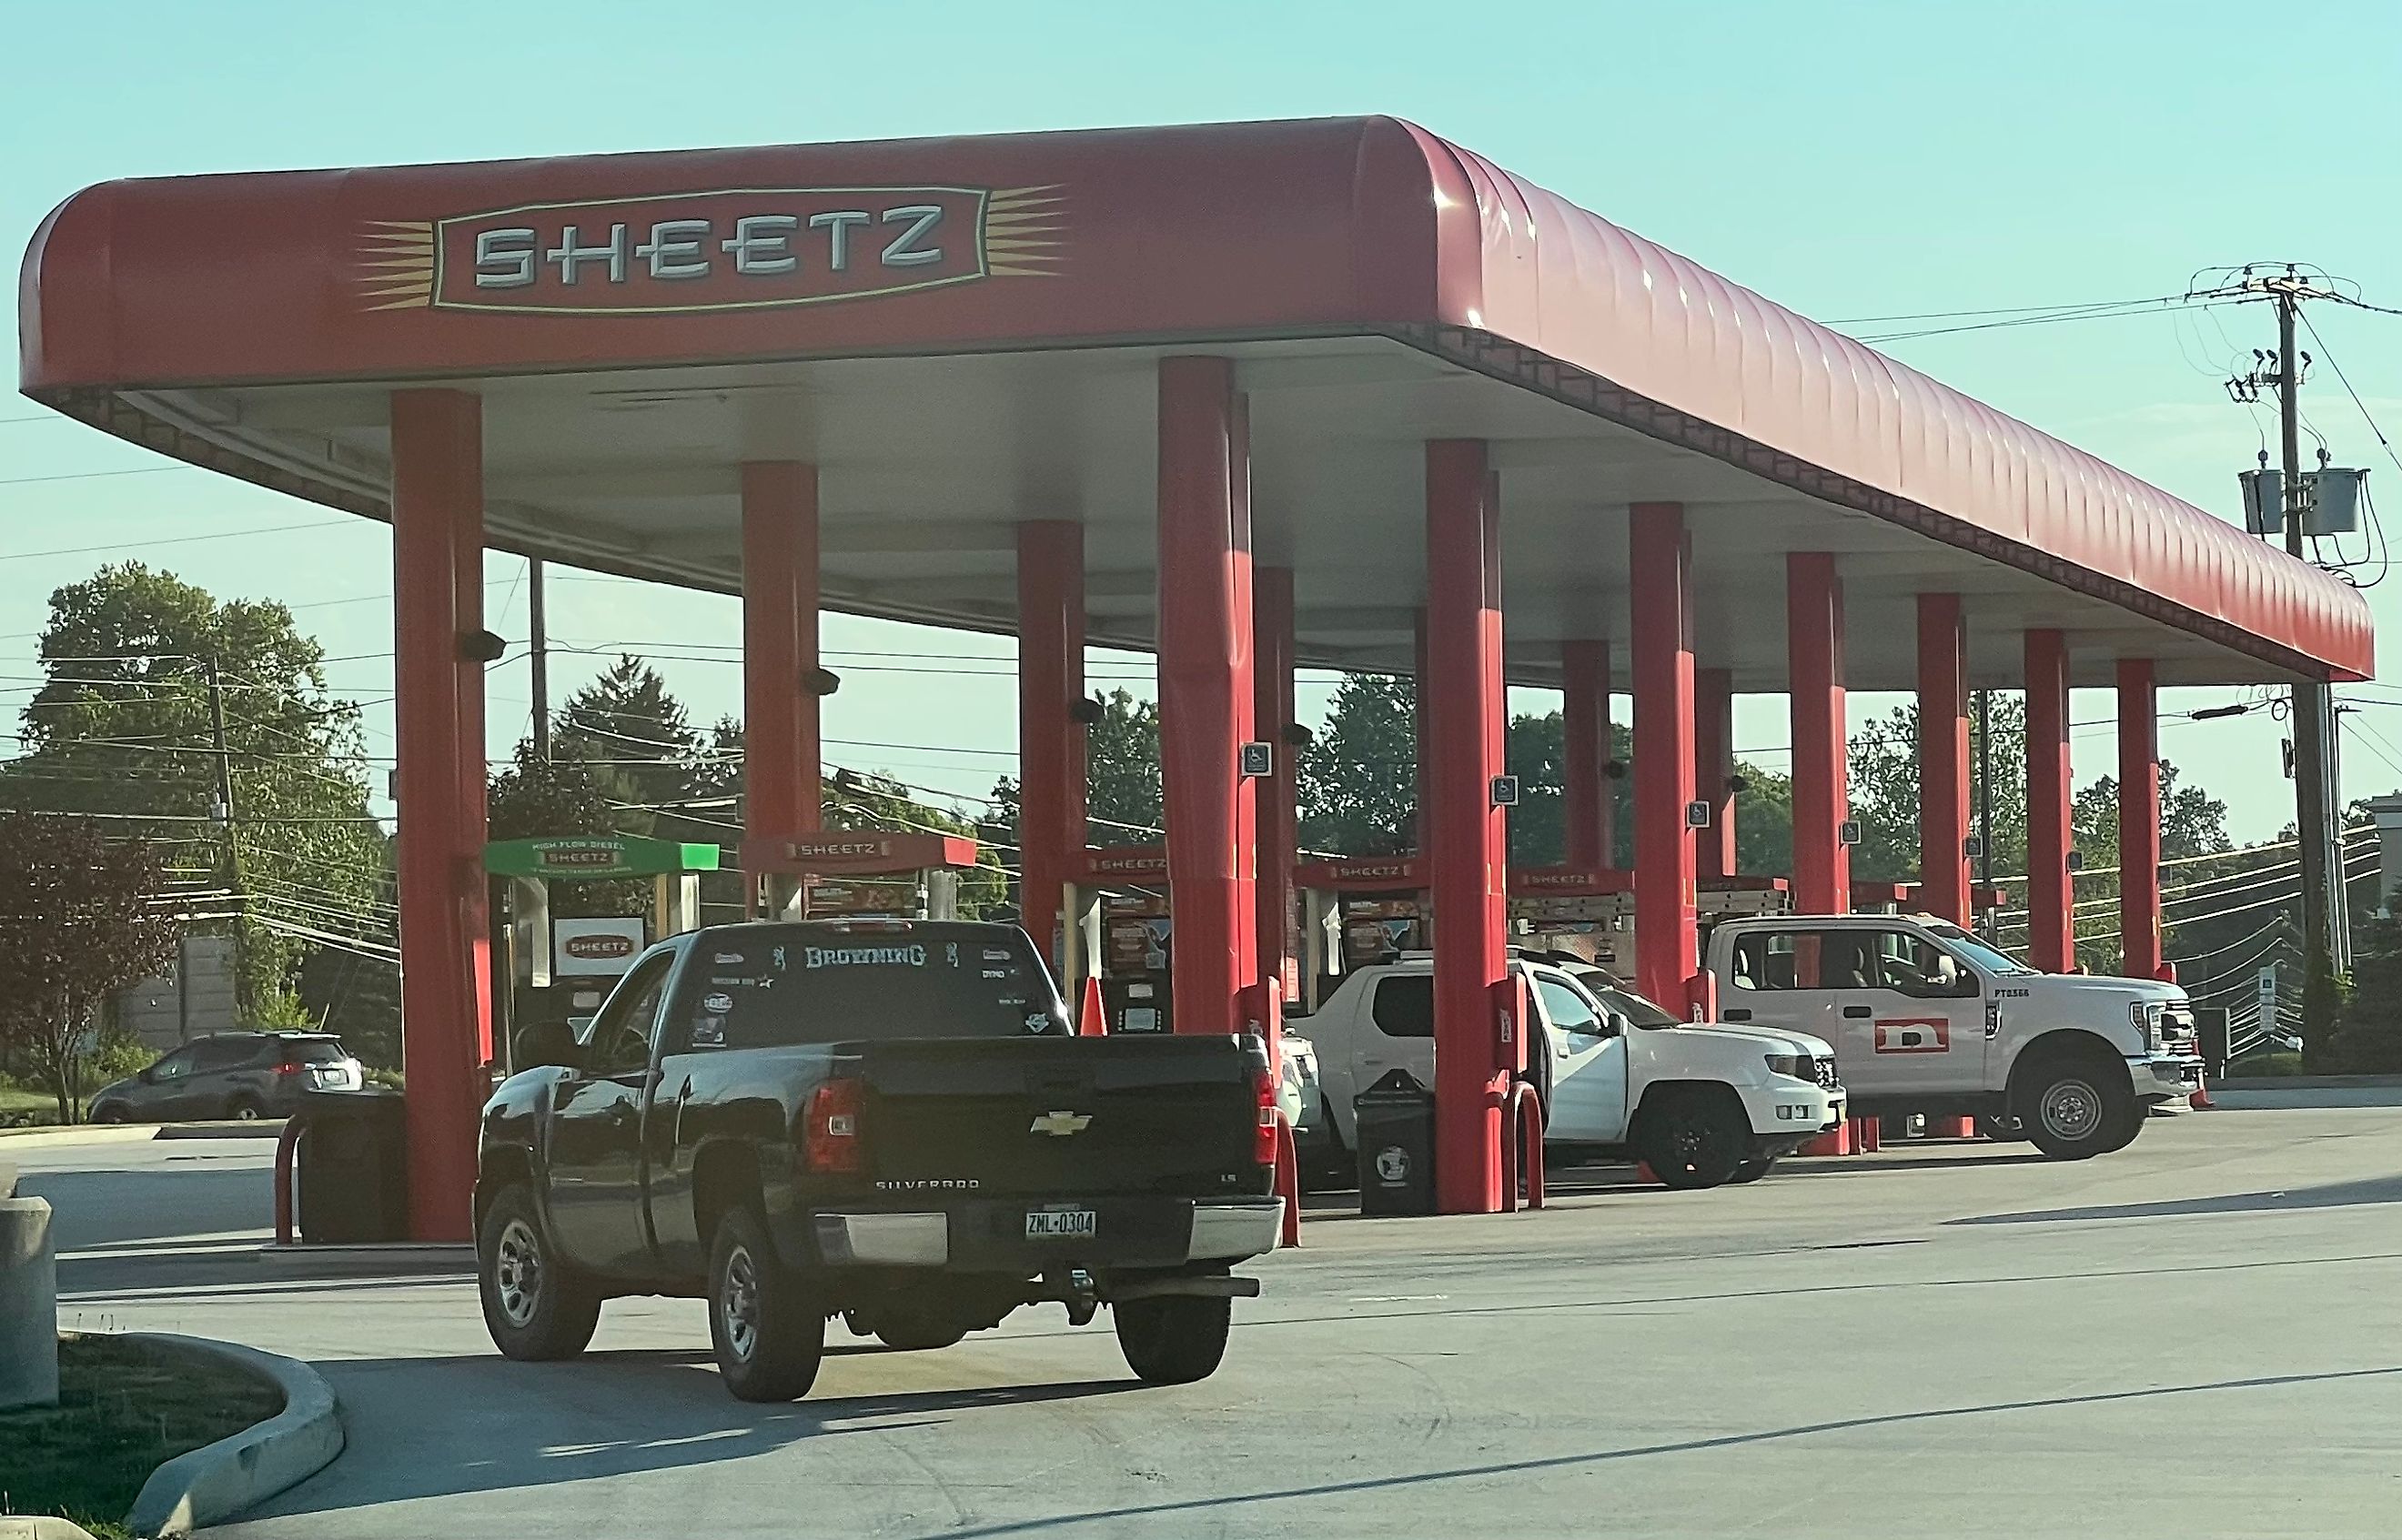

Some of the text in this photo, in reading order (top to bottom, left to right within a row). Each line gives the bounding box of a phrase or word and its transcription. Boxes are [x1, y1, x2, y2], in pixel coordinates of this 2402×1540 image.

[476, 205, 943, 287] SHEETZ
[590, 840, 626, 851] DIESEL
[801, 843, 875, 856] SHEETZ
[548, 852, 609, 863] SHEETZ
[1102, 859, 1166, 870] SHEETZ
[1340, 865, 1398, 876] SHEETZ
[1531, 874, 1585, 884] SHEETZ
[570, 941, 629, 952] SHEETZ
[805, 944, 927, 969] BROWNING
[875, 1179, 979, 1190] SILVERADO
